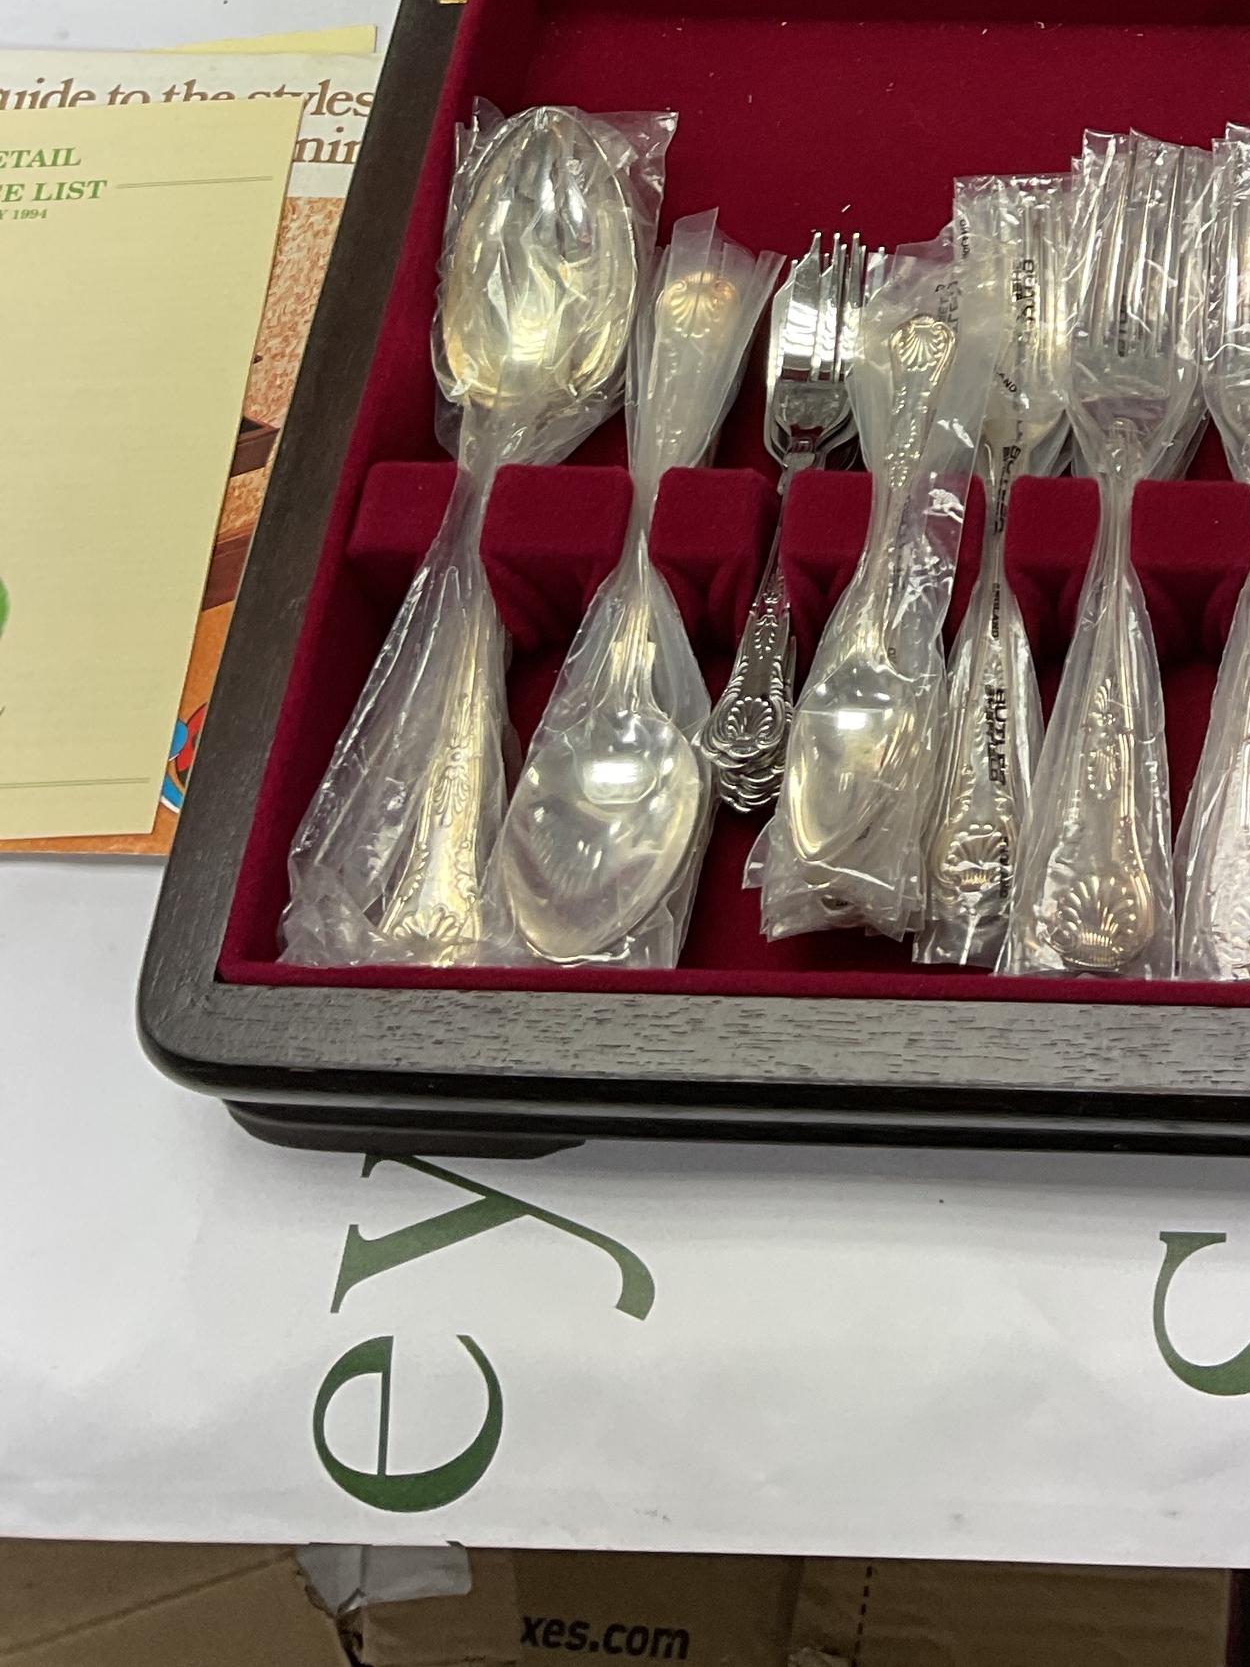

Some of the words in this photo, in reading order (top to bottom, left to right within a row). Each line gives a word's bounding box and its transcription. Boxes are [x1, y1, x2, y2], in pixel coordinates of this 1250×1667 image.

[31, 180, 107, 201] LIST
[12, 209, 47, 220] 1994
[520, 1616, 691, 1660] xes.com
